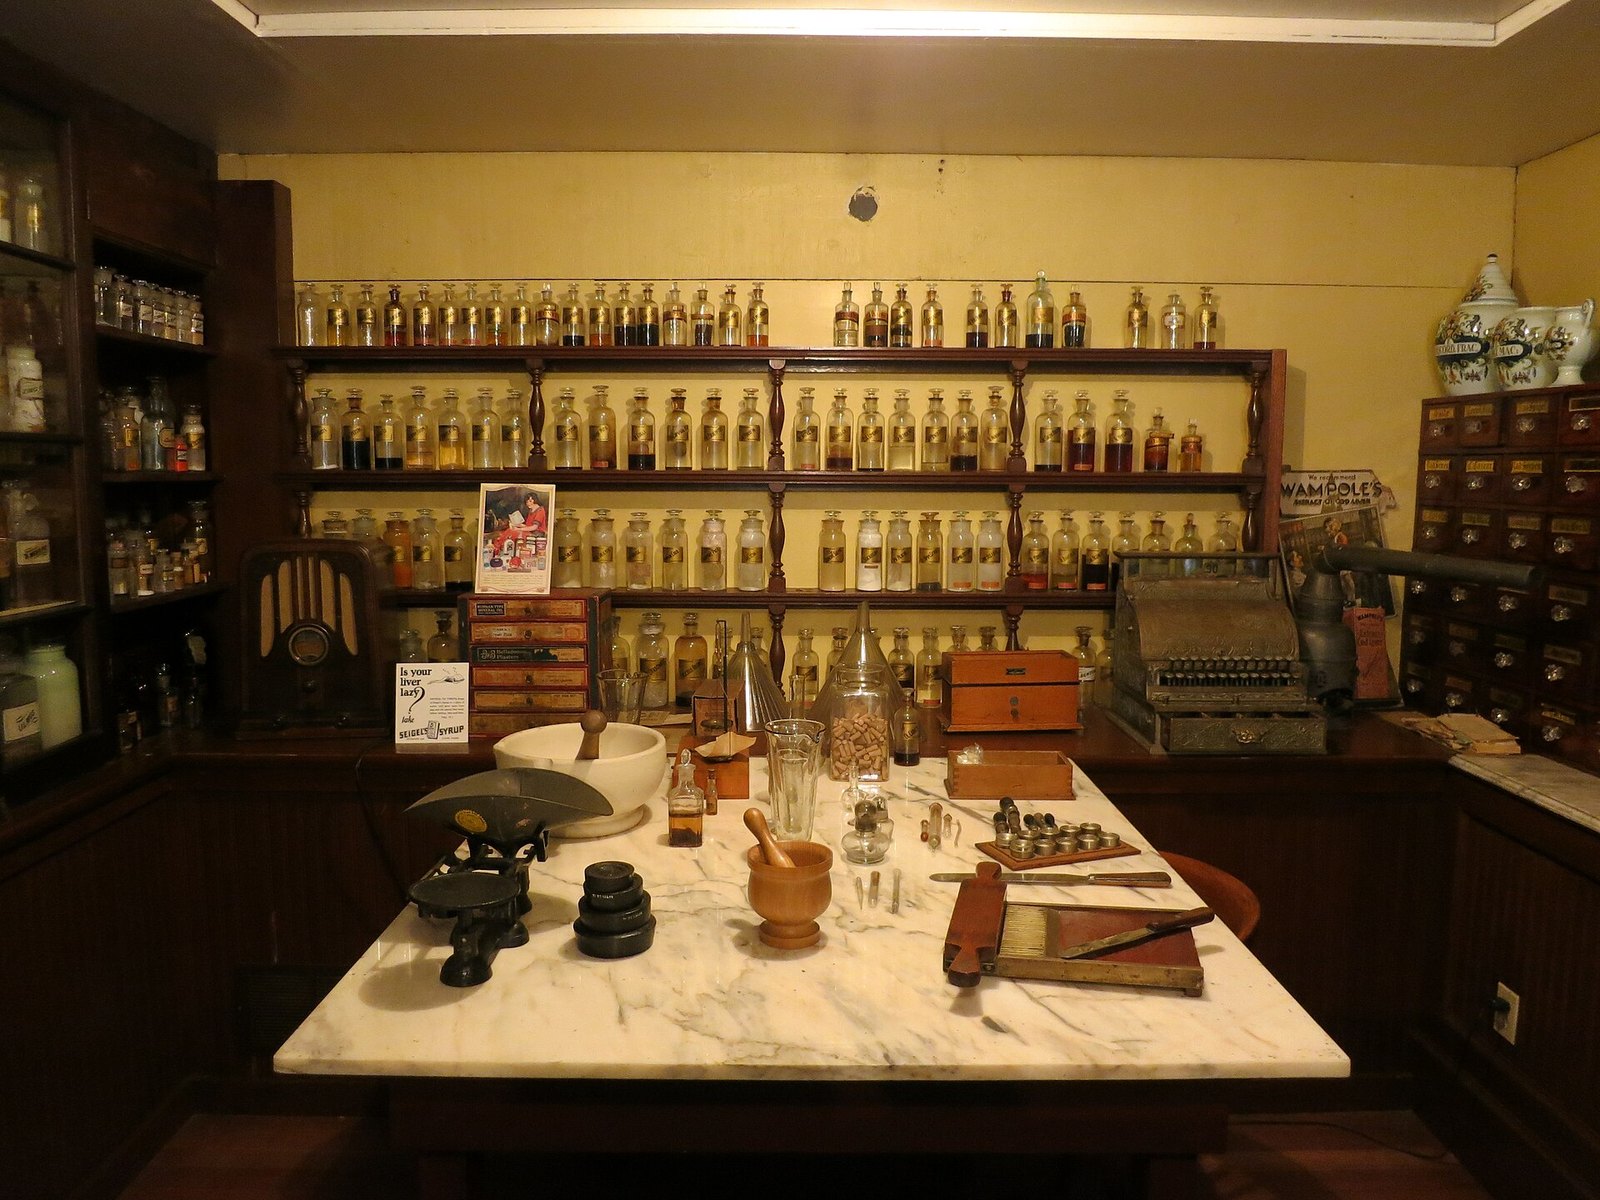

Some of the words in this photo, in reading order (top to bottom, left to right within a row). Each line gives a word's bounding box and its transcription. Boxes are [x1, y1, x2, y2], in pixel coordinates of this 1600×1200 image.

[1281, 481, 1383, 498] WAMPOLE'S
[400, 667, 408, 676] Is
[410, 669, 432, 677] your
[400, 677, 421, 686] liver
[440, 725, 464, 735] SYRUP
